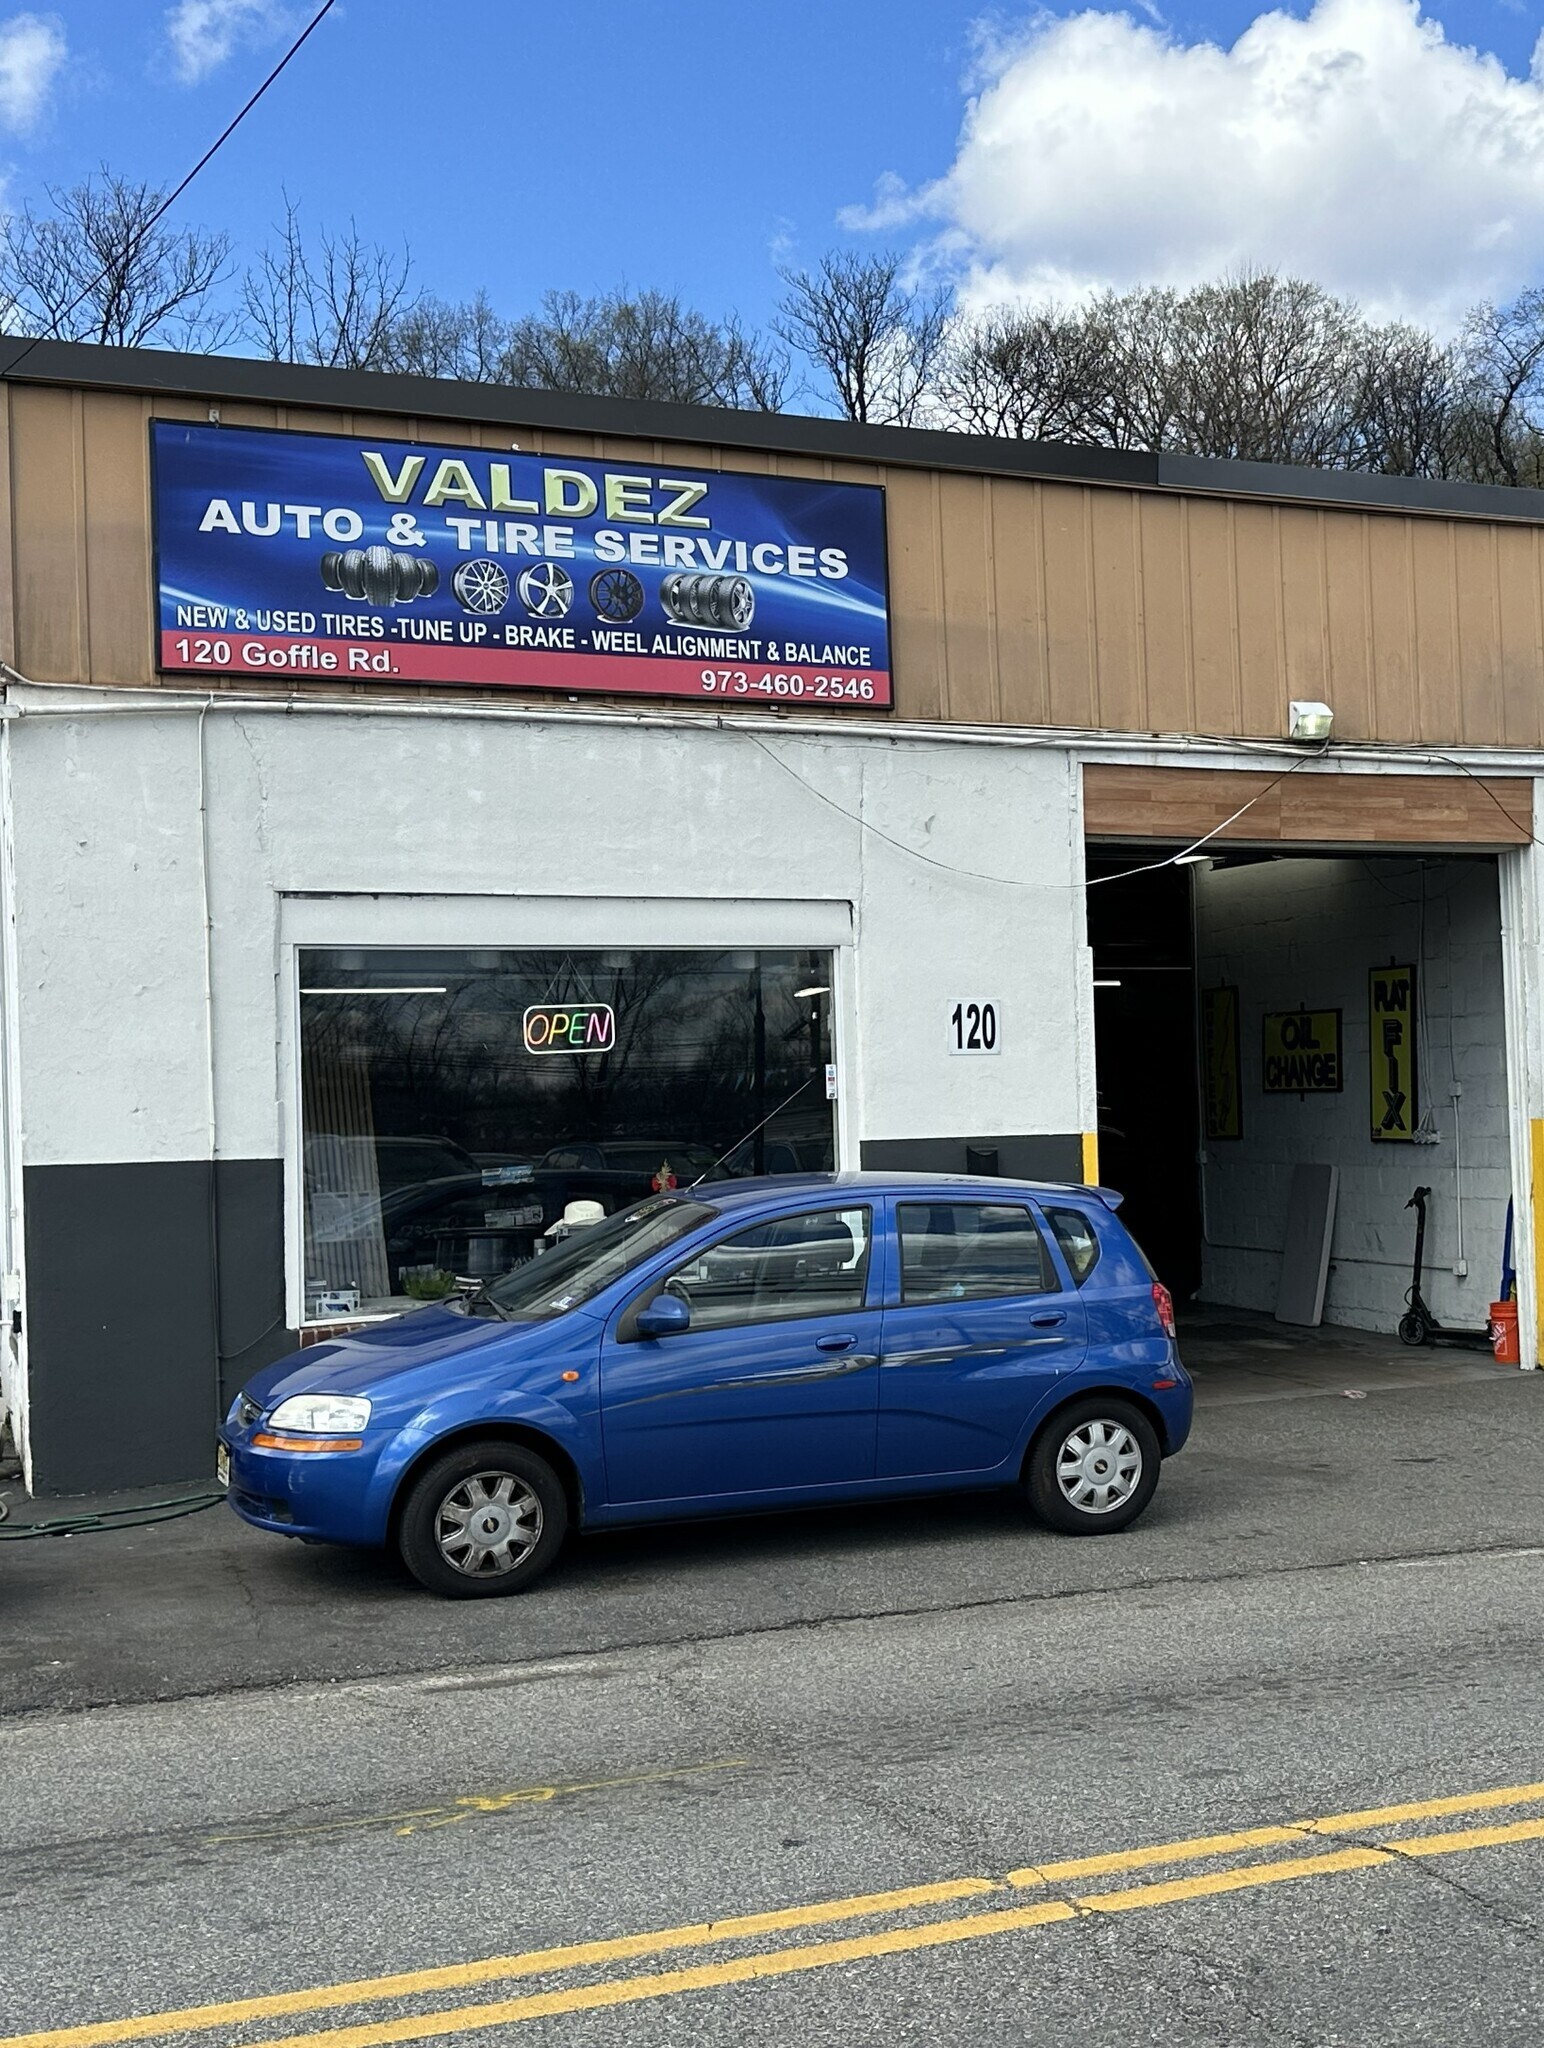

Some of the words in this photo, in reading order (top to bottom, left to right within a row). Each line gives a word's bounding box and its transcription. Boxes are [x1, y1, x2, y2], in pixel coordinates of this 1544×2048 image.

[360, 451, 710, 528] VALDEZ
[199, 499, 364, 542] AUTO
[386, 513, 427, 547] &
[446, 517, 575, 558] TIRE
[593, 530, 849, 579] SERVICES
[176, 605, 228, 628] NEW
[234, 608, 250, 629] &
[256, 609, 316, 634] USED
[322, 613, 384, 637] TIRES
[460, 622, 487, 643] UP
[505, 625, 575, 649] BRAKE
[592, 630, 648, 654] WEEL
[652, 635, 761, 660] ALIGNMENT
[767, 642, 780, 662] &
[785, 643, 871, 666] BALANCE
[176, 639, 231, 664] 120
[242, 642, 338, 670] Goffle
[349, 648, 400, 673] Rd.
[701, 670, 874, 699] 973-460-2546
[528, 1012, 610, 1045] OPEN
[952, 1003, 996, 1049] 120
[1281, 1016, 1320, 1050] OIL
[1266, 1053, 1335, 1088] CHANGE
[1381, 1019, 1407, 1131] FIX
